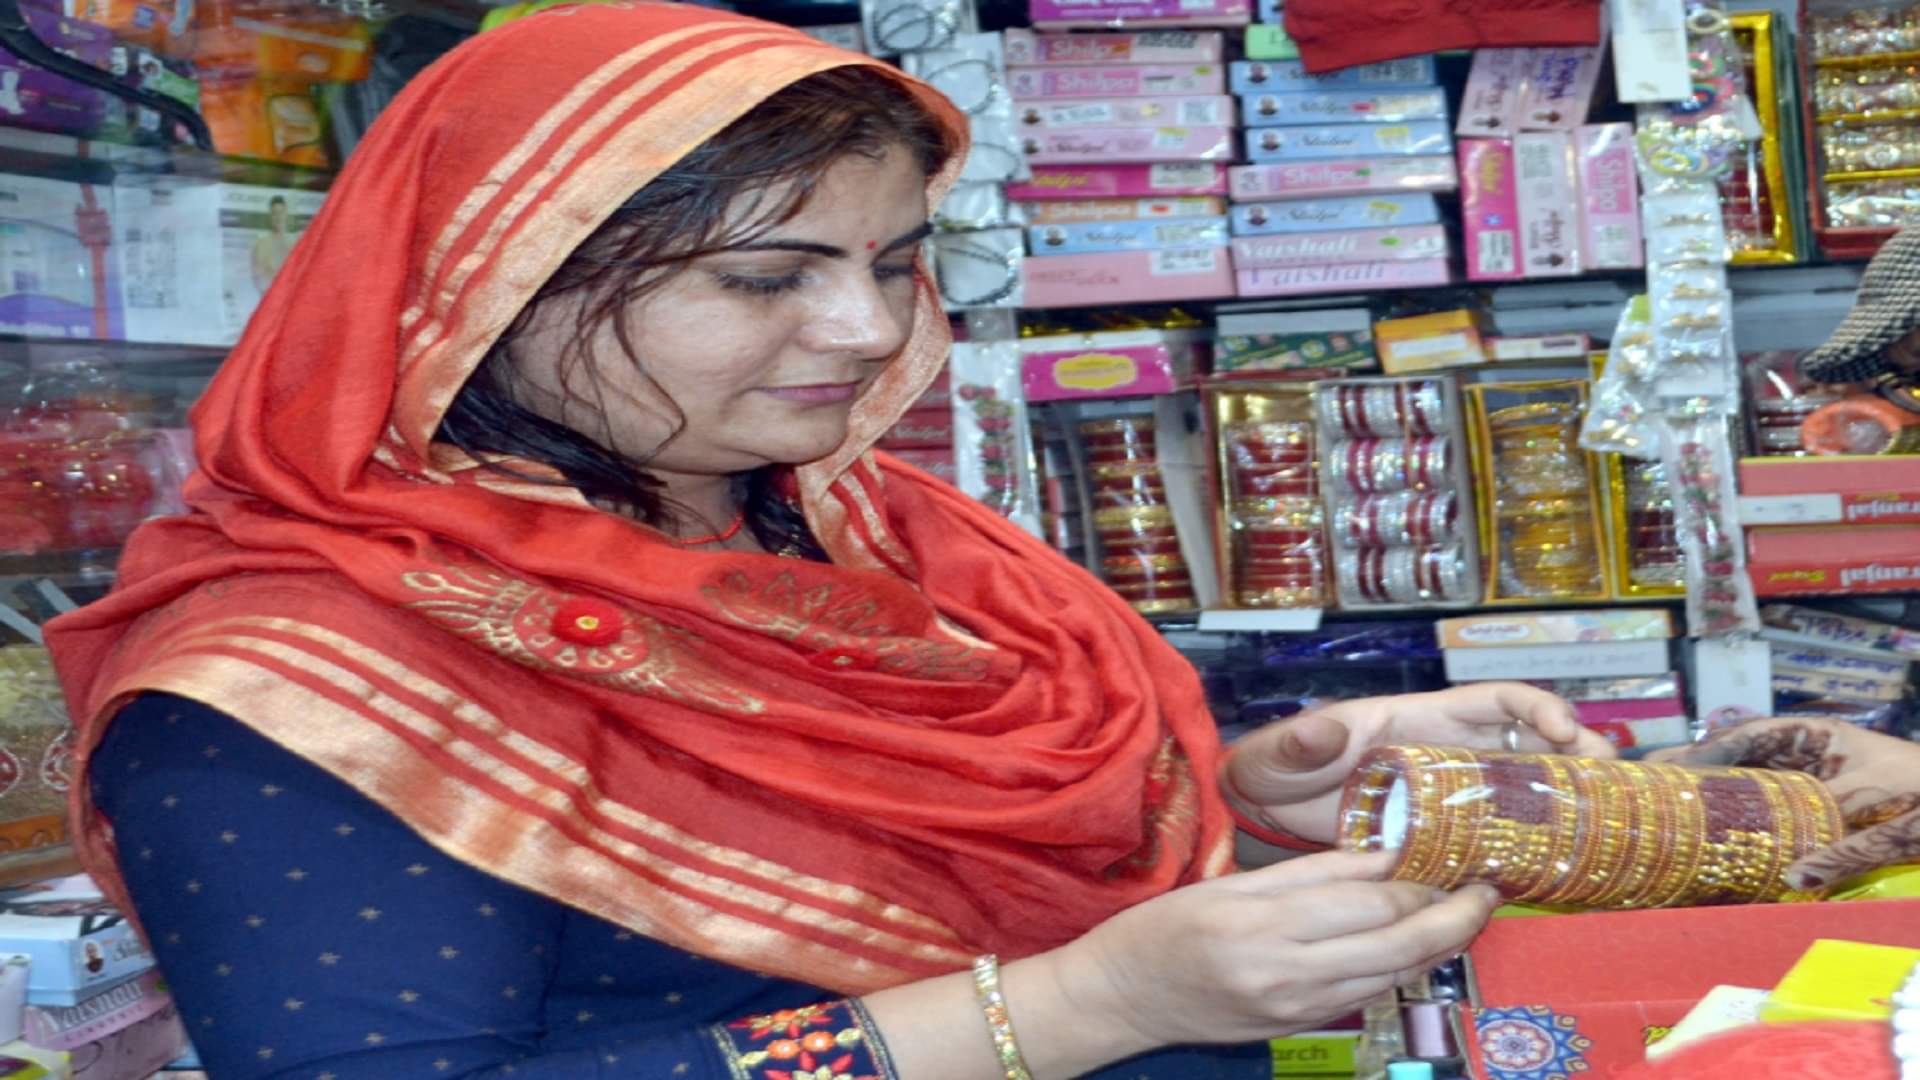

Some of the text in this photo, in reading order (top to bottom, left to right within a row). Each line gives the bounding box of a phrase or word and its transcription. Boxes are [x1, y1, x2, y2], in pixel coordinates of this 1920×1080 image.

[1052, 37, 1124, 60] Shilp
[1597, 158, 1627, 210] Shilpa
[1238, 235, 1360, 259] Vaishali
